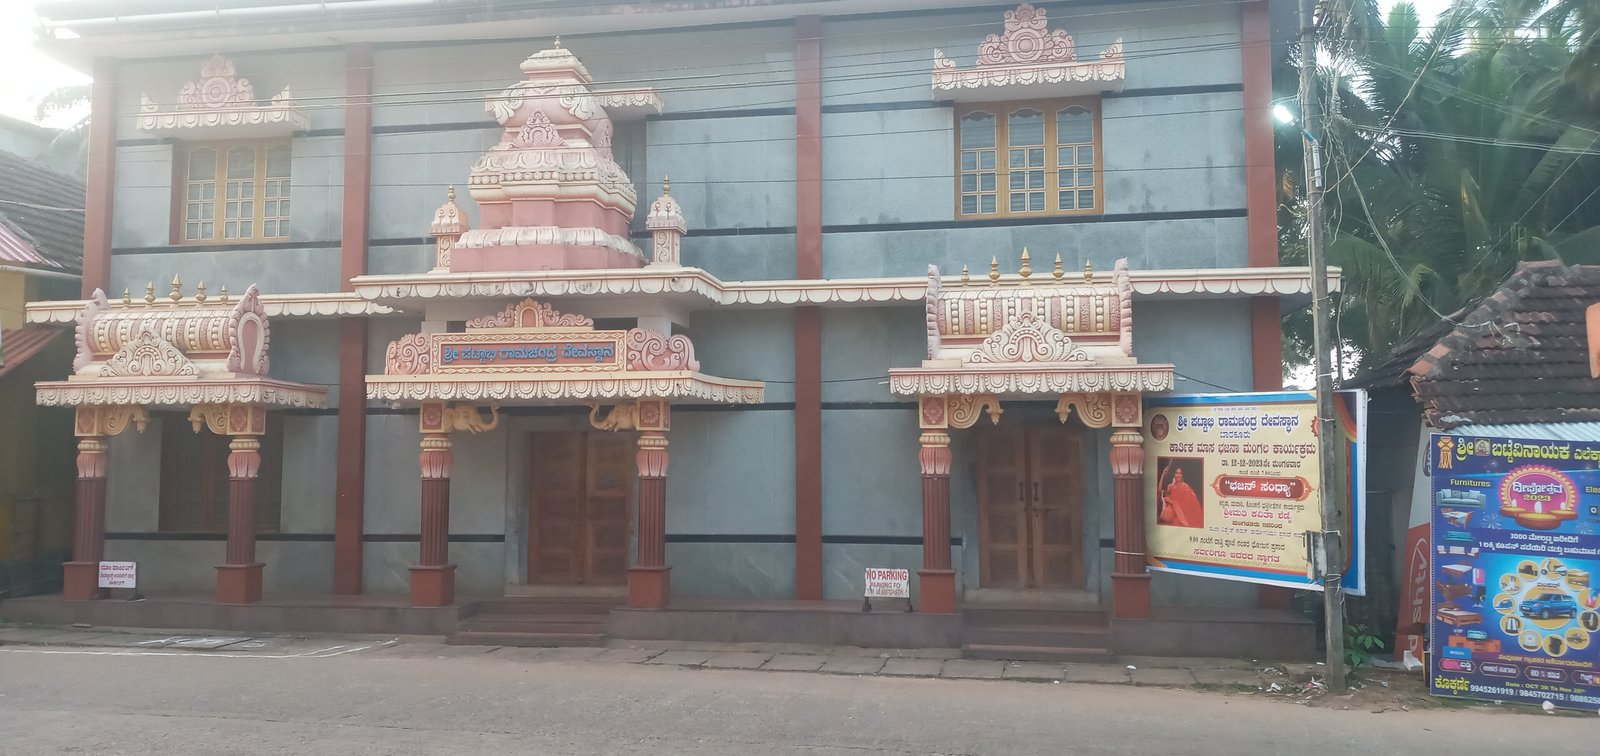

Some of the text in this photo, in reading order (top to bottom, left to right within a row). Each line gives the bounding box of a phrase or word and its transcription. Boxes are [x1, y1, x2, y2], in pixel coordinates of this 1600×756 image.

[444, 346, 459, 363] ಶ್ರೀ
[498, 345, 558, 363] ರಾಮಚಂದ್ರ
[561, 343, 614, 363] ದೇವಸ್ಥಾನ
[1177, 413, 1299, 433] ಶ್ರೀ ಪಟ್ಟಾಭಿ ರಾಮಚಂದ್ರ ದೇವಸ್ಥಾನ
[1169, 443, 1316, 458] ಕಾರ್ತಿಕ ಮಾಸ ಭಜನಾ ಮಂಗಲ ಕಾರ್ಯಕ್ರಮ
[1455, 437, 1474, 461] ಶ್ರೀ
[1491, 439, 1570, 463] ಬಟ್ಟೆವಿನಾಯಕ
[1272, 459, 1301, 468] ಮಂಗಳವಾರ
[1450, 478, 1491, 487] Furnitures
[1223, 509, 1248, 519] ಶ್ರೀಮತಿ
[1510, 533, 1527, 541] 3000
[866, 570, 907, 581] NO PARKING
[1470, 684, 1514, 695] 9945261919
[1519, 689, 1564, 701] 9845702715
